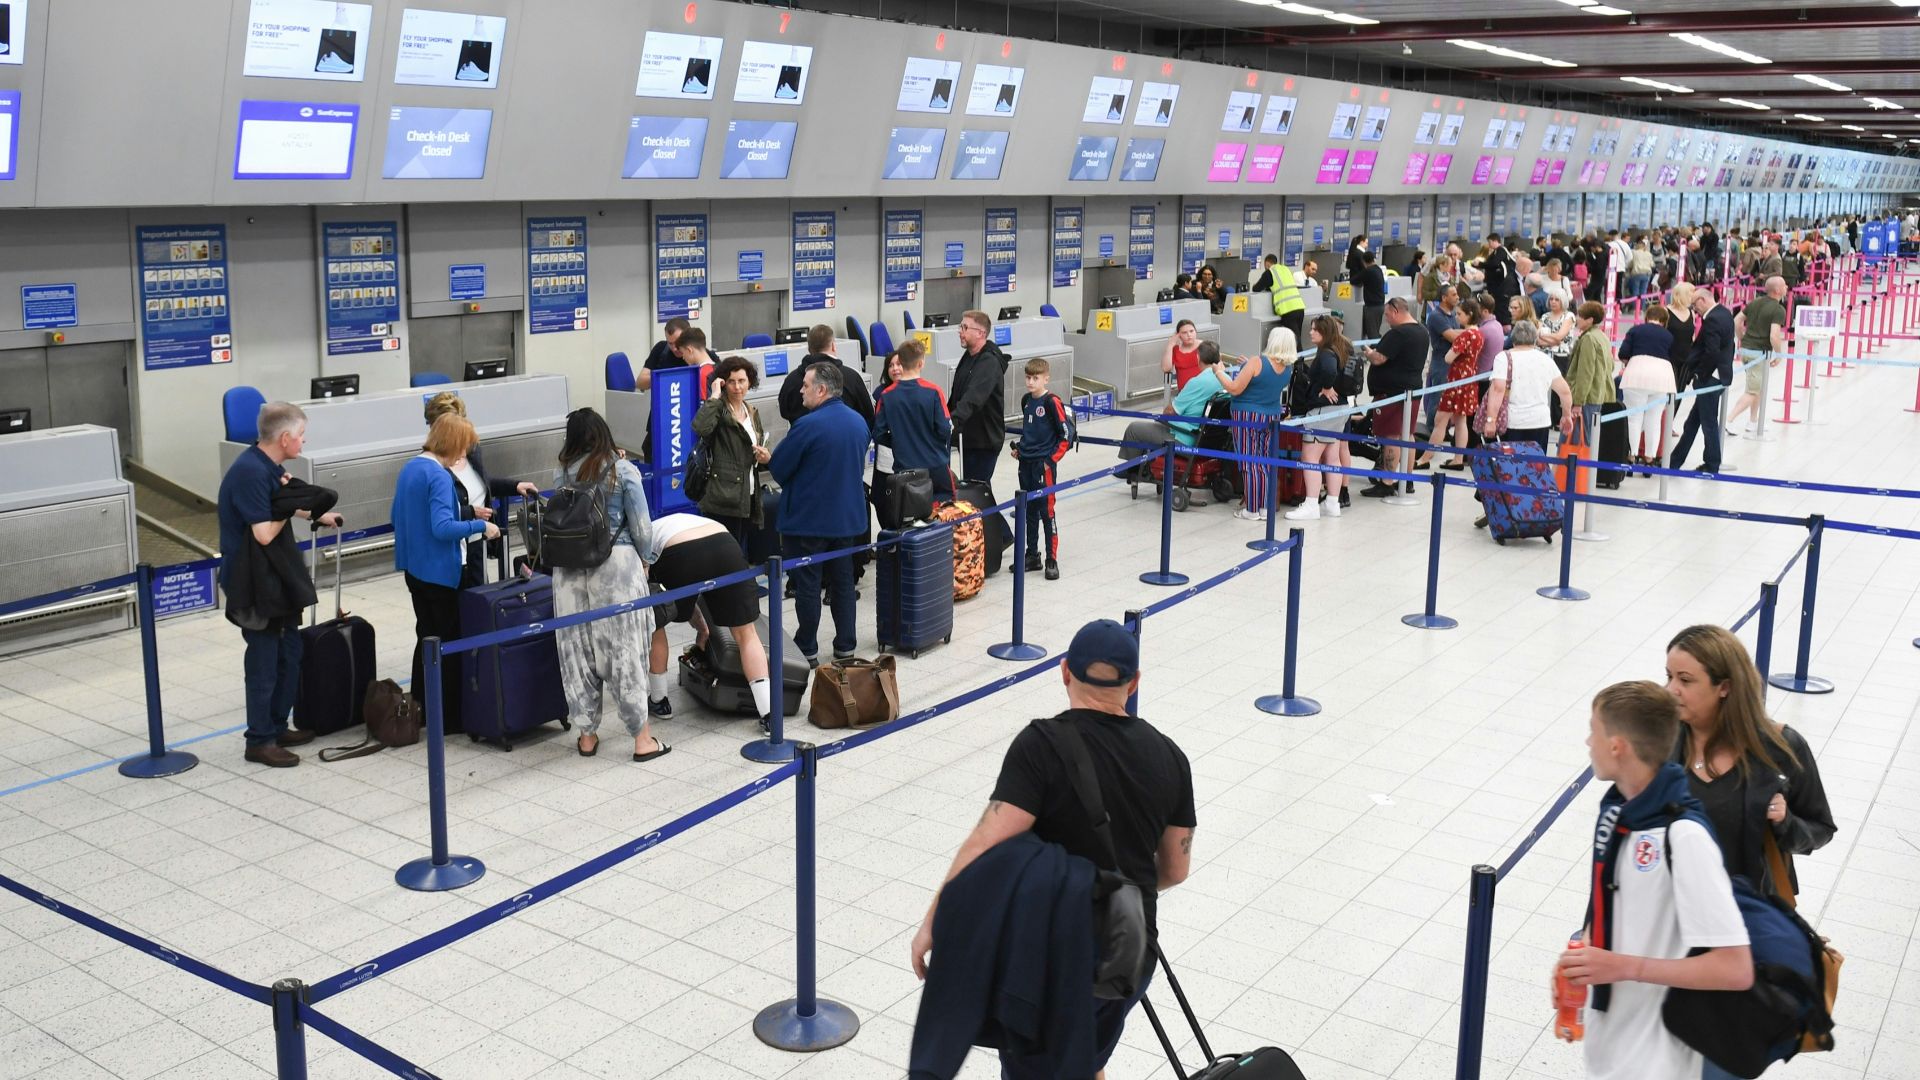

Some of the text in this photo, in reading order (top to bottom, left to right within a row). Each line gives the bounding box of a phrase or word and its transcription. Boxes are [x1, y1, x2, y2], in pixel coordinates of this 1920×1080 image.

[684, 2, 697, 24] 6
[779, 12, 791, 34] 7
[282, 25, 310, 33] SHOPPING
[406, 130, 471, 143] Check-in Desk
[642, 136, 692, 147] Check-in Desk
[738, 139, 781, 150] Check-in Desk
[898, 143, 932, 153] Check-in Desk
[422, 144, 453, 157] Closed
[653, 149, 677, 159] Closed
[966, 145, 996, 155] Check-in Desk
[747, 151, 768, 161] Closed
[904, 154, 922, 163] Closed
[971, 156, 987, 164] Closed
[142, 228, 219, 239] Important Information
[328, 225, 392, 235] Important Information
[671, 381, 682, 475] RYANAIR
[1296, 462, 1320, 470] Departure
[164, 572, 195, 584] NOTICE
[155, 591, 180, 599] baggage
[340, 977, 358, 988] LONDON
[358, 971, 373, 980] LUTON
